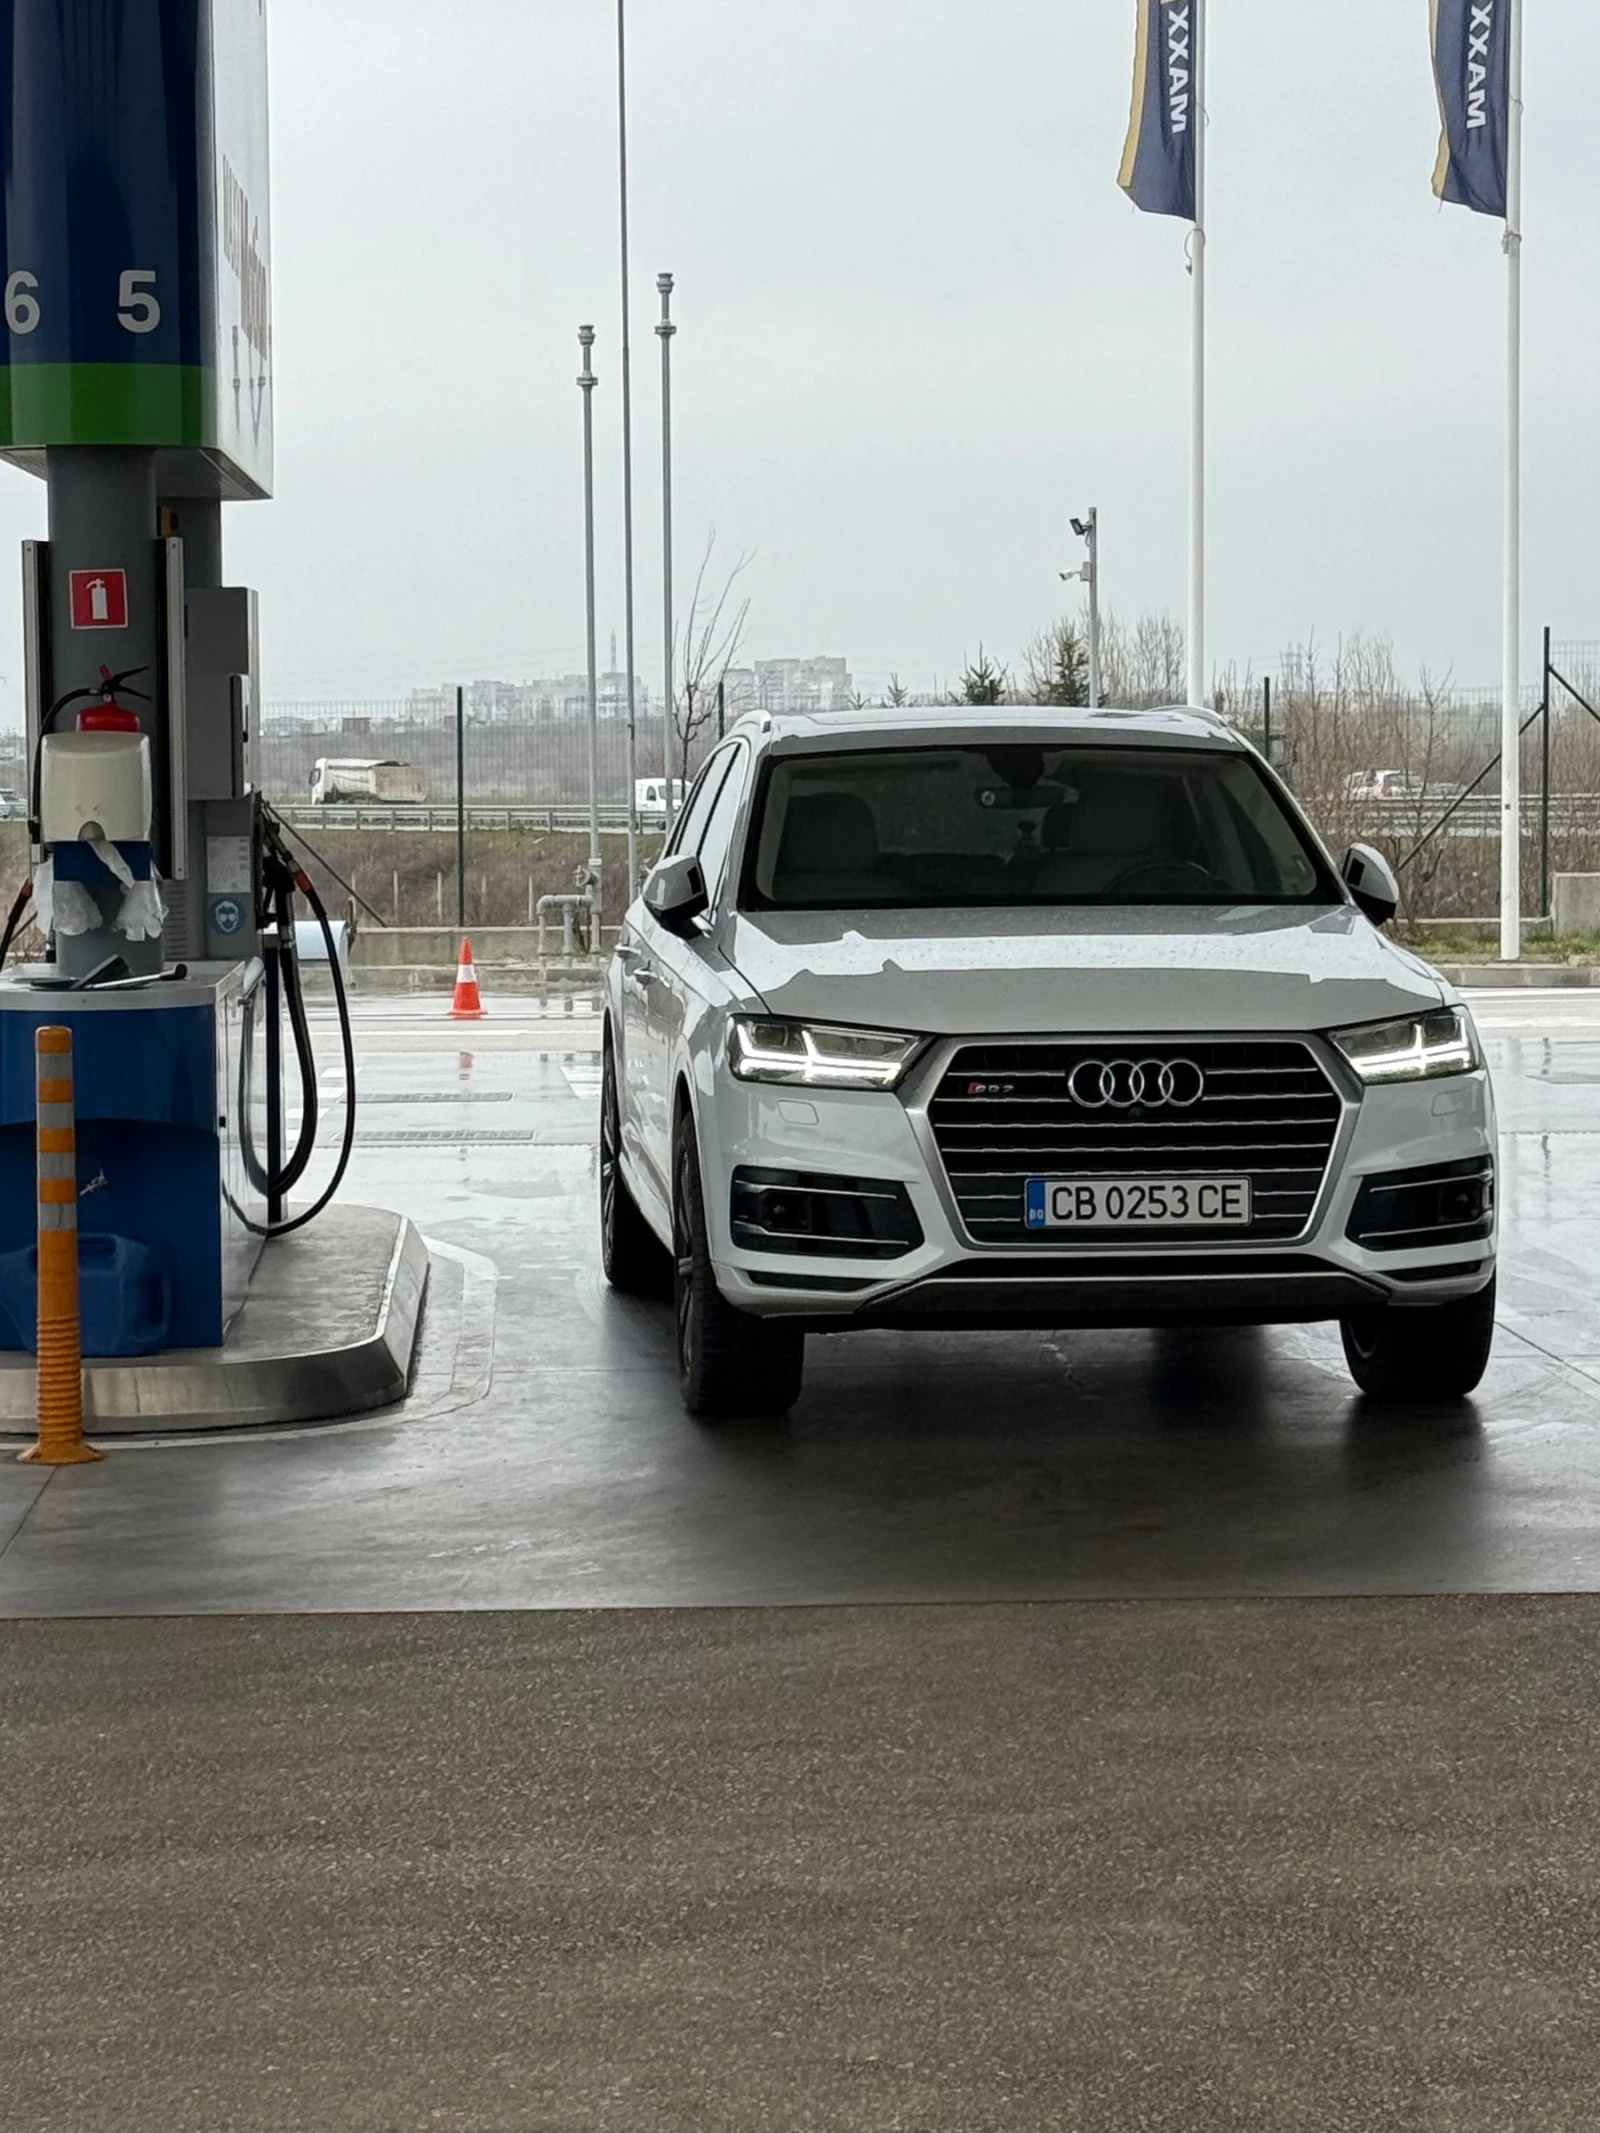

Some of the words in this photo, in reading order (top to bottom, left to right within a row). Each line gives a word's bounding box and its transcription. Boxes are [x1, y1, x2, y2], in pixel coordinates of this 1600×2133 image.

[4, 270, 41, 335] 6
[116, 269, 161, 334] 5
[1051, 1186, 1097, 1220] CB
[1104, 1184, 1190, 1220] 0253
[1197, 1183, 1244, 1219] CE
